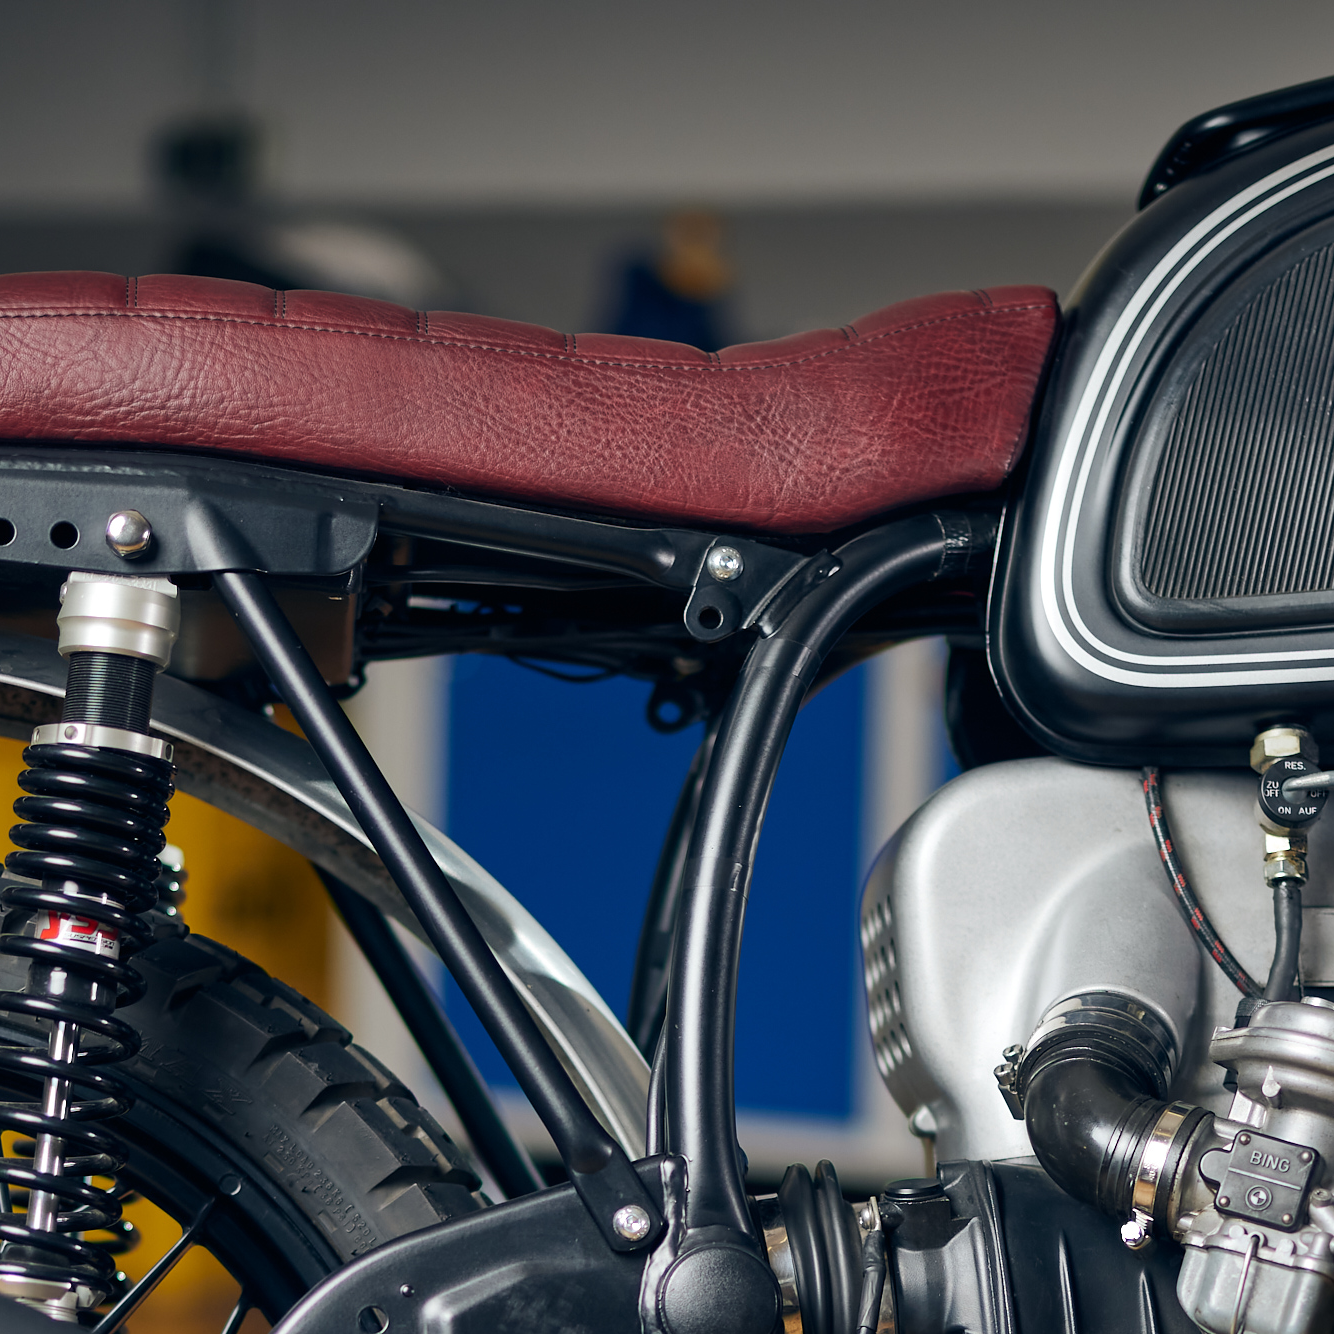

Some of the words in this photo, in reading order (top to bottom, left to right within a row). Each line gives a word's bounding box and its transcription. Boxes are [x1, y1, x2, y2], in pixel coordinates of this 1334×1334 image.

[1284, 761, 1307, 771] RES.
[1266, 780, 1280, 789] ZU
[1277, 806, 1292, 815] ON
[1298, 806, 1318, 815] AUF
[288, 1142, 316, 1170] LOAD
[1249, 1150, 1291, 1173] BING
